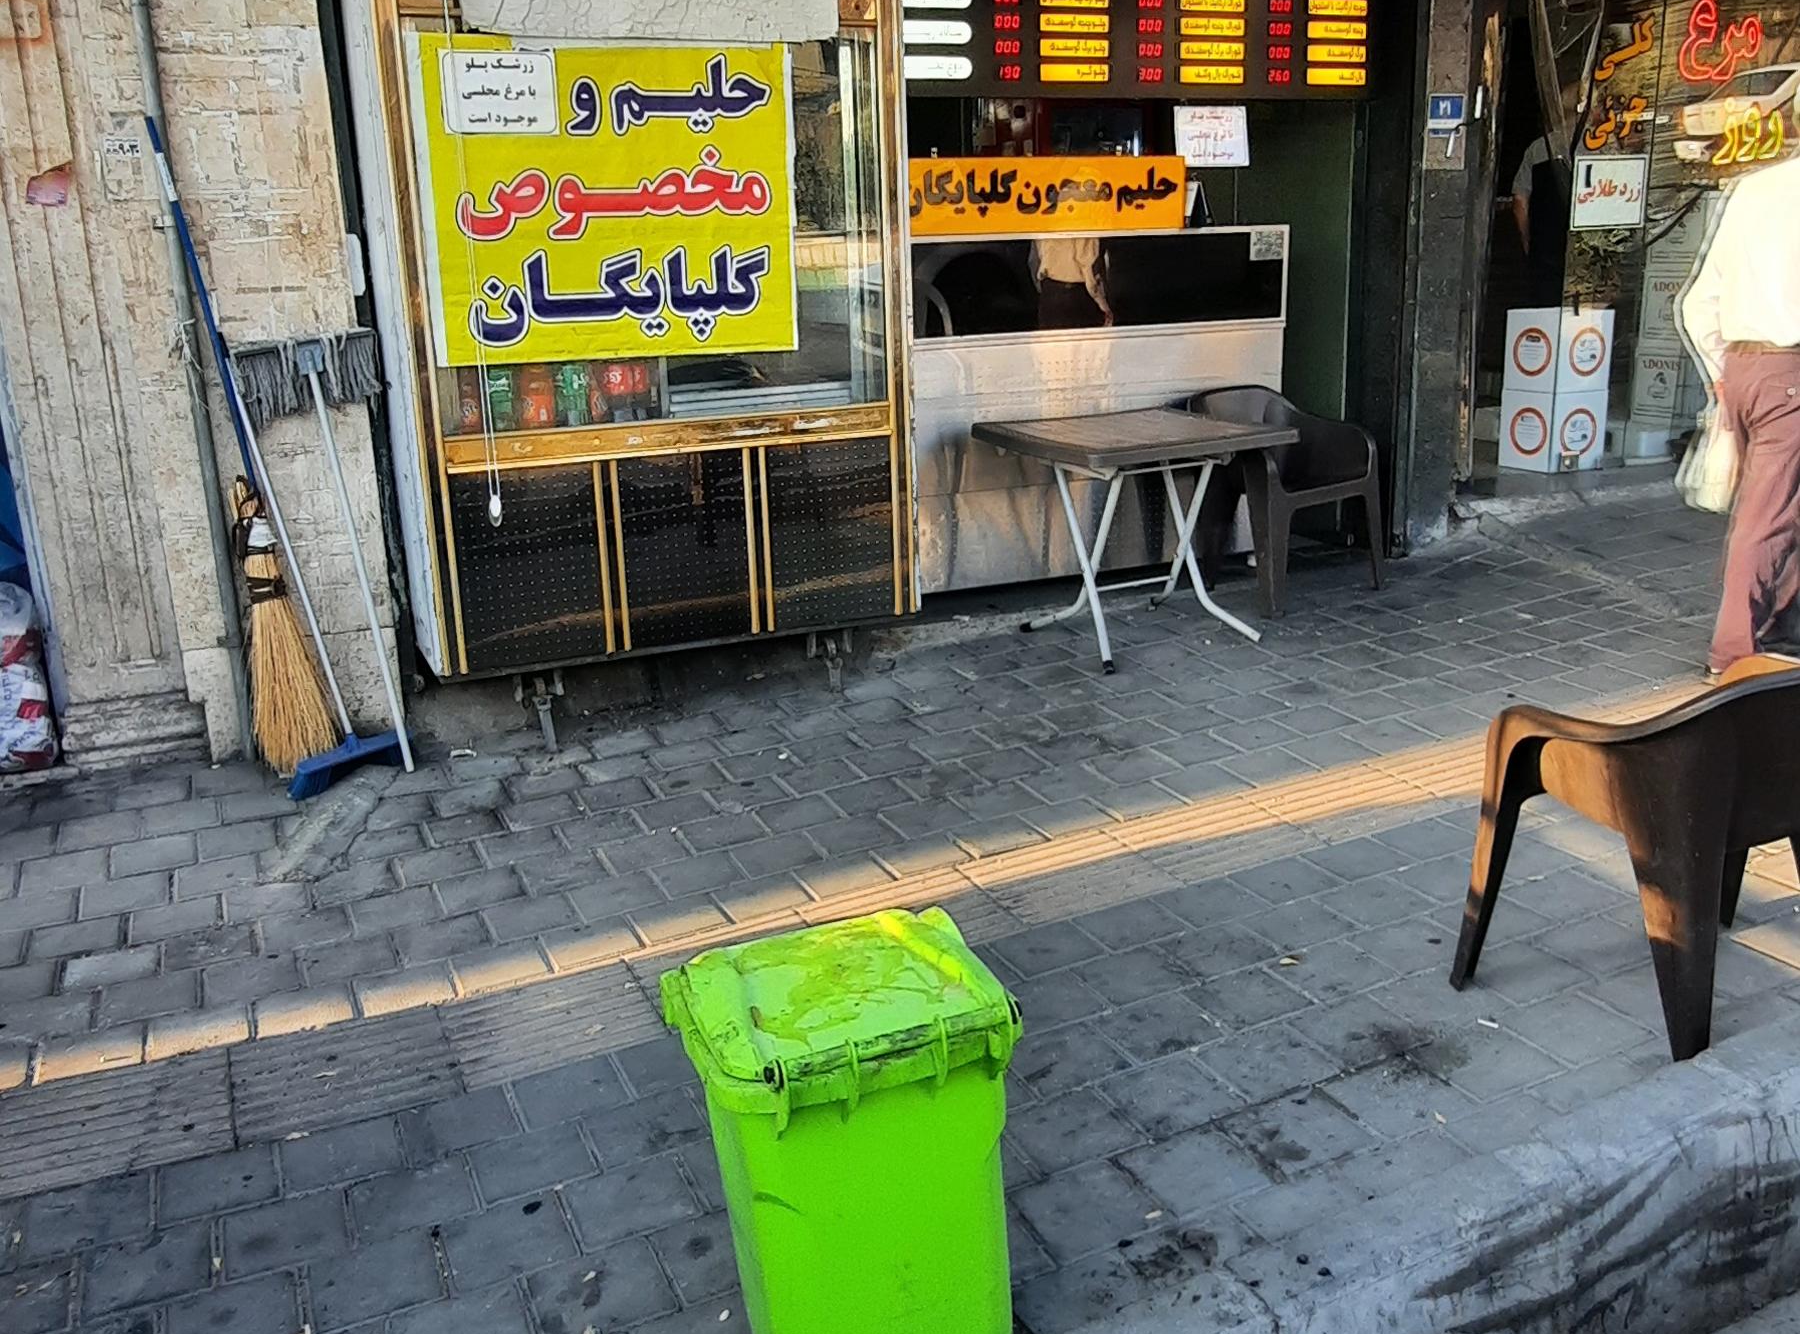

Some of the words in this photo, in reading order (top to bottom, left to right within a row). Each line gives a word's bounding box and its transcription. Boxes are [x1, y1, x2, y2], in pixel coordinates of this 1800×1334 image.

[1269, 0, 1291, 12] 000
[994, 15, 1020, 28] 000
[1138, 19, 1162, 32] 000
[1269, 23, 1291, 35] 000
[995, 40, 1020, 54] 000
[1138, 43, 1162, 56] 000
[1268, 47, 1291, 59] 000
[1594, 14, 1655, 81] کلی
[491, 57, 534, 73] زرشک
[462, 85, 500, 100] مجلسی
[504, 83, 525, 100] مرغ
[528, 85, 536, 100] با
[610, 53, 772, 135] حلیم
[565, 75, 602, 136] و
[468, 112, 491, 123] است
[495, 114, 538, 127] موجود
[1584, 94, 1648, 151] جزئی
[456, 144, 770, 241] مخصوص
[1016, 177, 1113, 215] معجون
[1117, 166, 1178, 212] حلیم
[468, 244, 770, 346] گلپایگان
